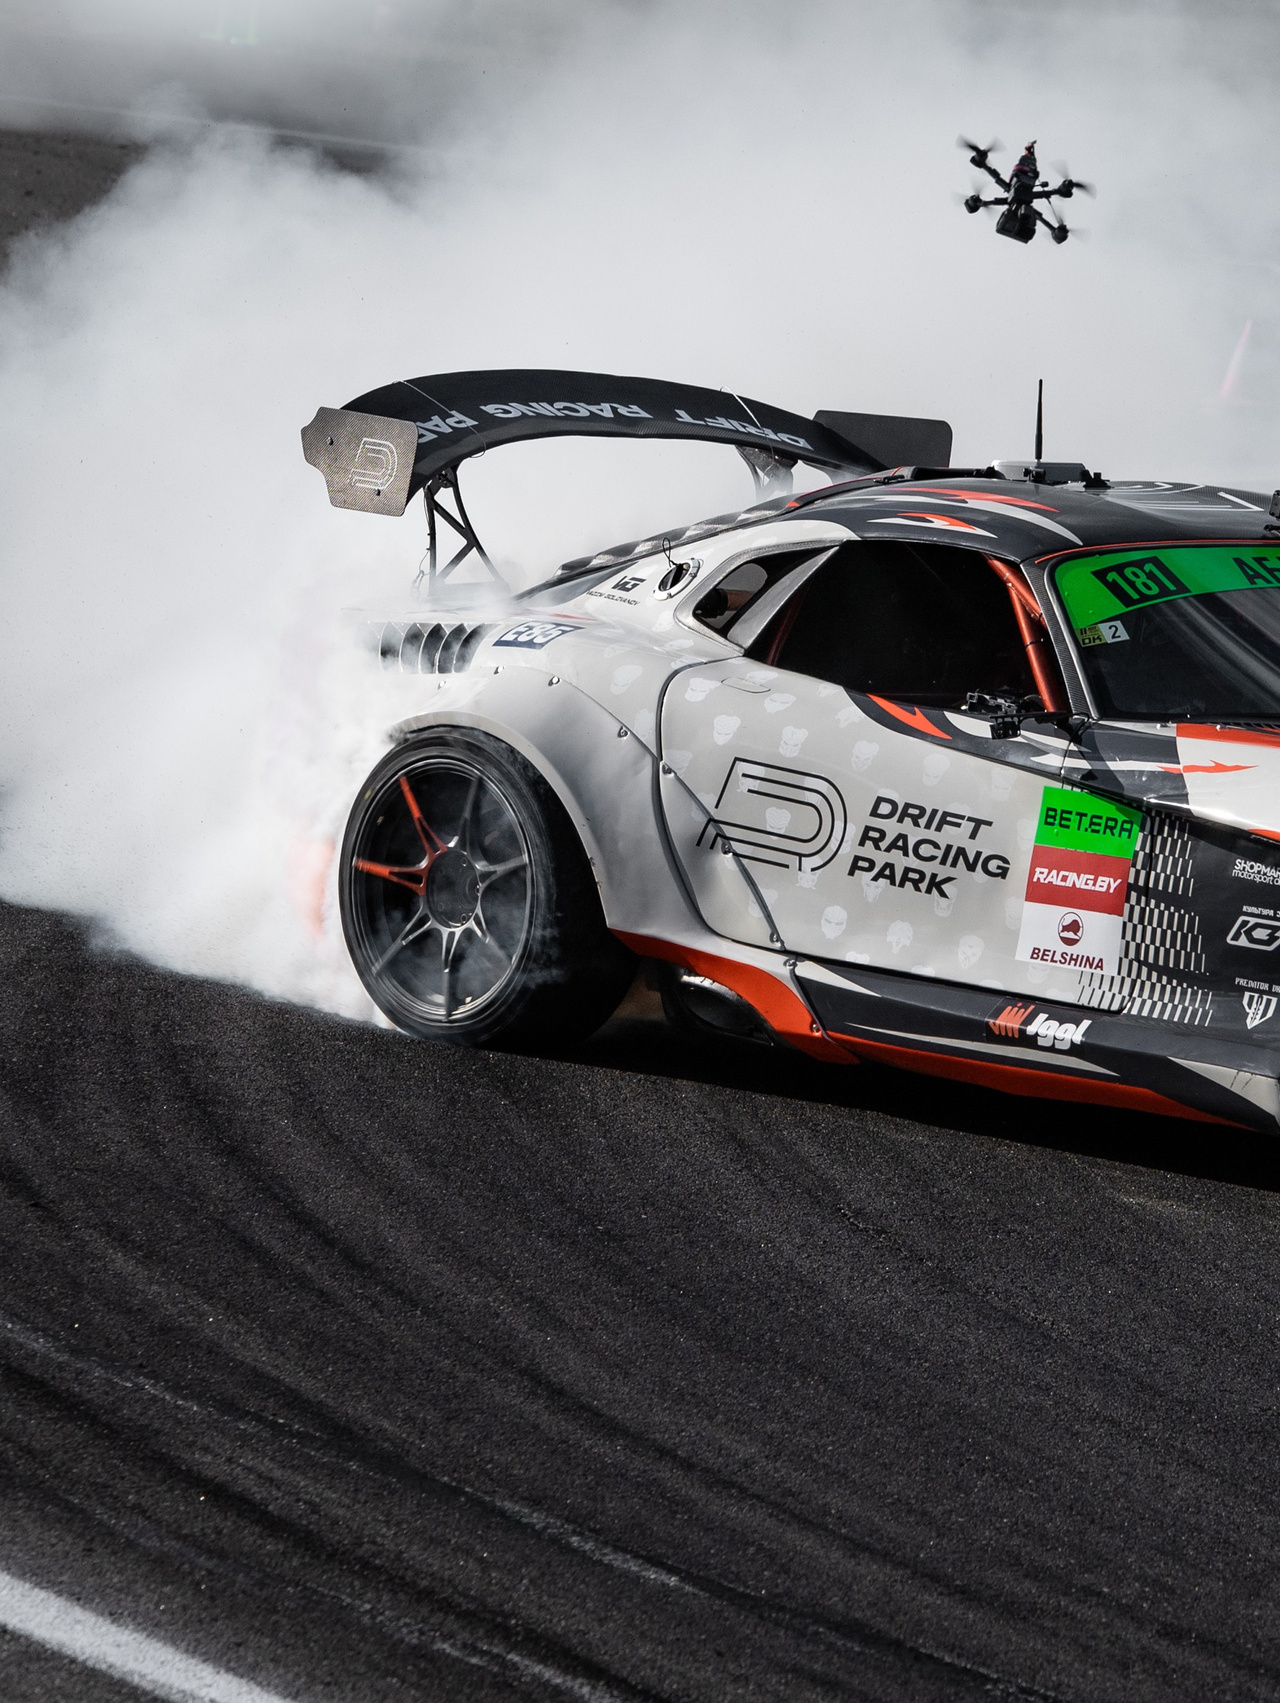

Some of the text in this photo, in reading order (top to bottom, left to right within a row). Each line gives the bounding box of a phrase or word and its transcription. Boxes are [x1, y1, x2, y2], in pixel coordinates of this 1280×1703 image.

[479, 402, 654, 419] RACING
[675, 409, 815, 451] DRIFT
[1106, 562, 1177, 599] 181
[500, 621, 576, 644] E85
[1108, 625, 1121, 640] 2
[868, 795, 994, 841] DRIFT
[857, 824, 1012, 880] RACING
[847, 854, 958, 900] PARK
[1032, 866, 1123, 894] RACING.BY
[1231, 869, 1274, 885] motorsport
[1242, 904, 1275, 917] КУЛЬТУРА
[1029, 946, 1105, 972] BELSHINA
